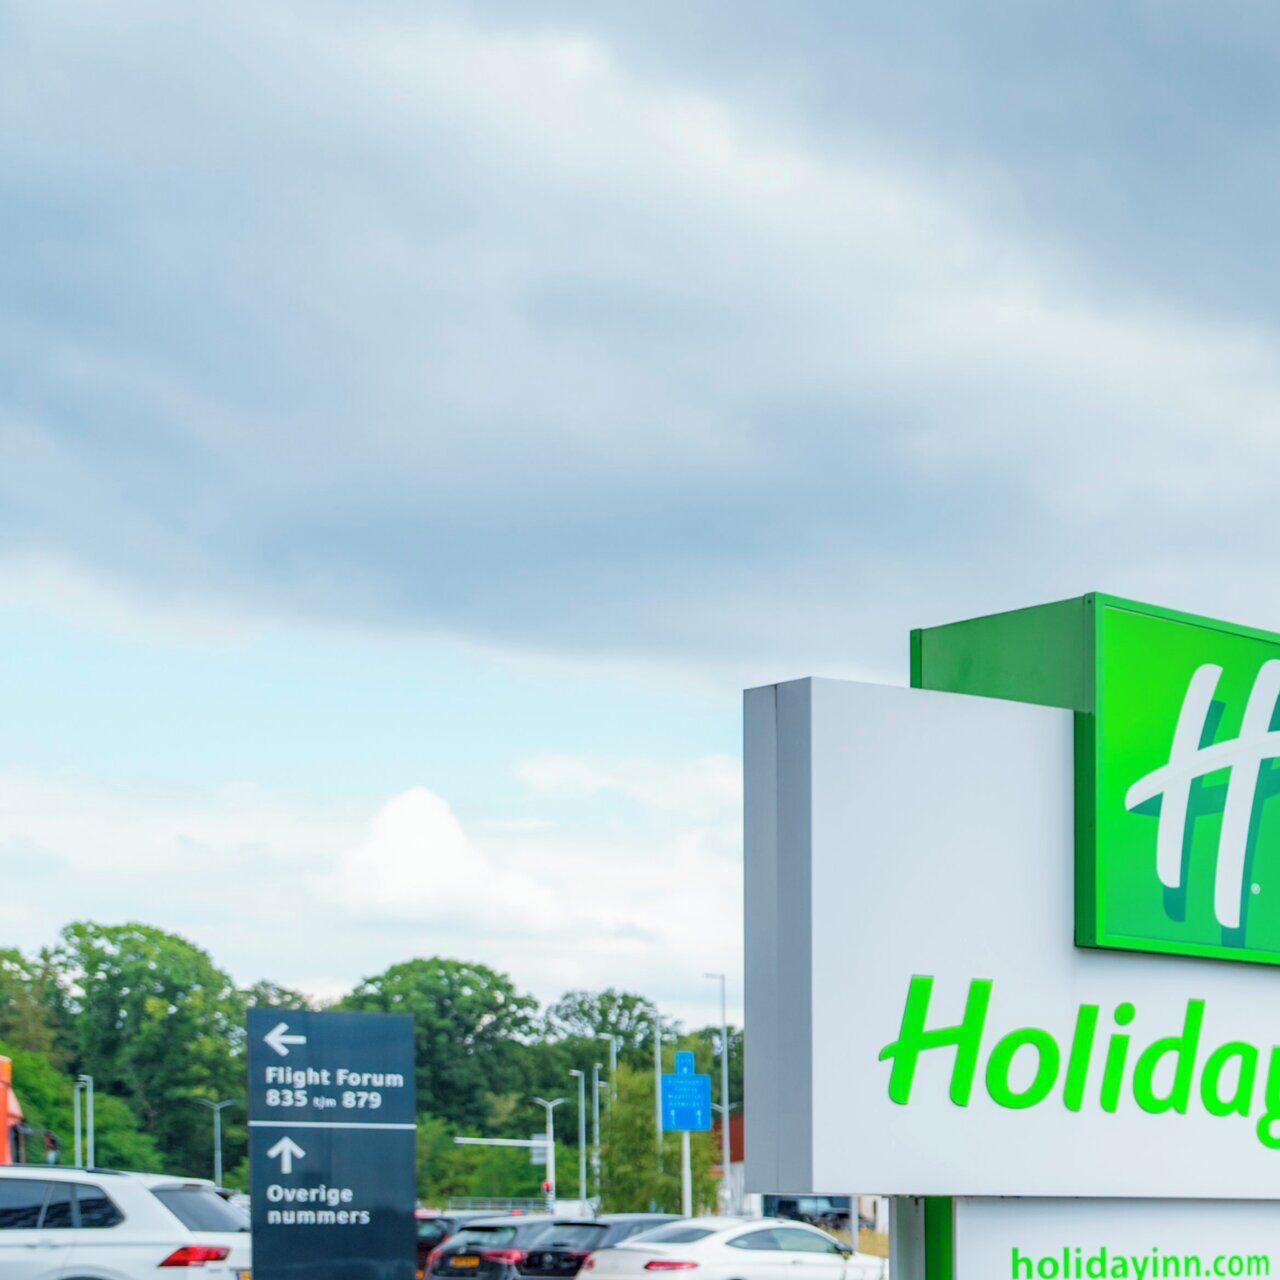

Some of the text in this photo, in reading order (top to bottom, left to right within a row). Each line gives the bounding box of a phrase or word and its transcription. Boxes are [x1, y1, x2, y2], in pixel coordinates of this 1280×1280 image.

[265, 1066, 404, 1089] Flight Forum
[265, 1089, 308, 1107] 835
[342, 1091, 382, 1109] 879
[266, 1184, 354, 1207] Overige
[267, 1209, 371, 1225] nummers
